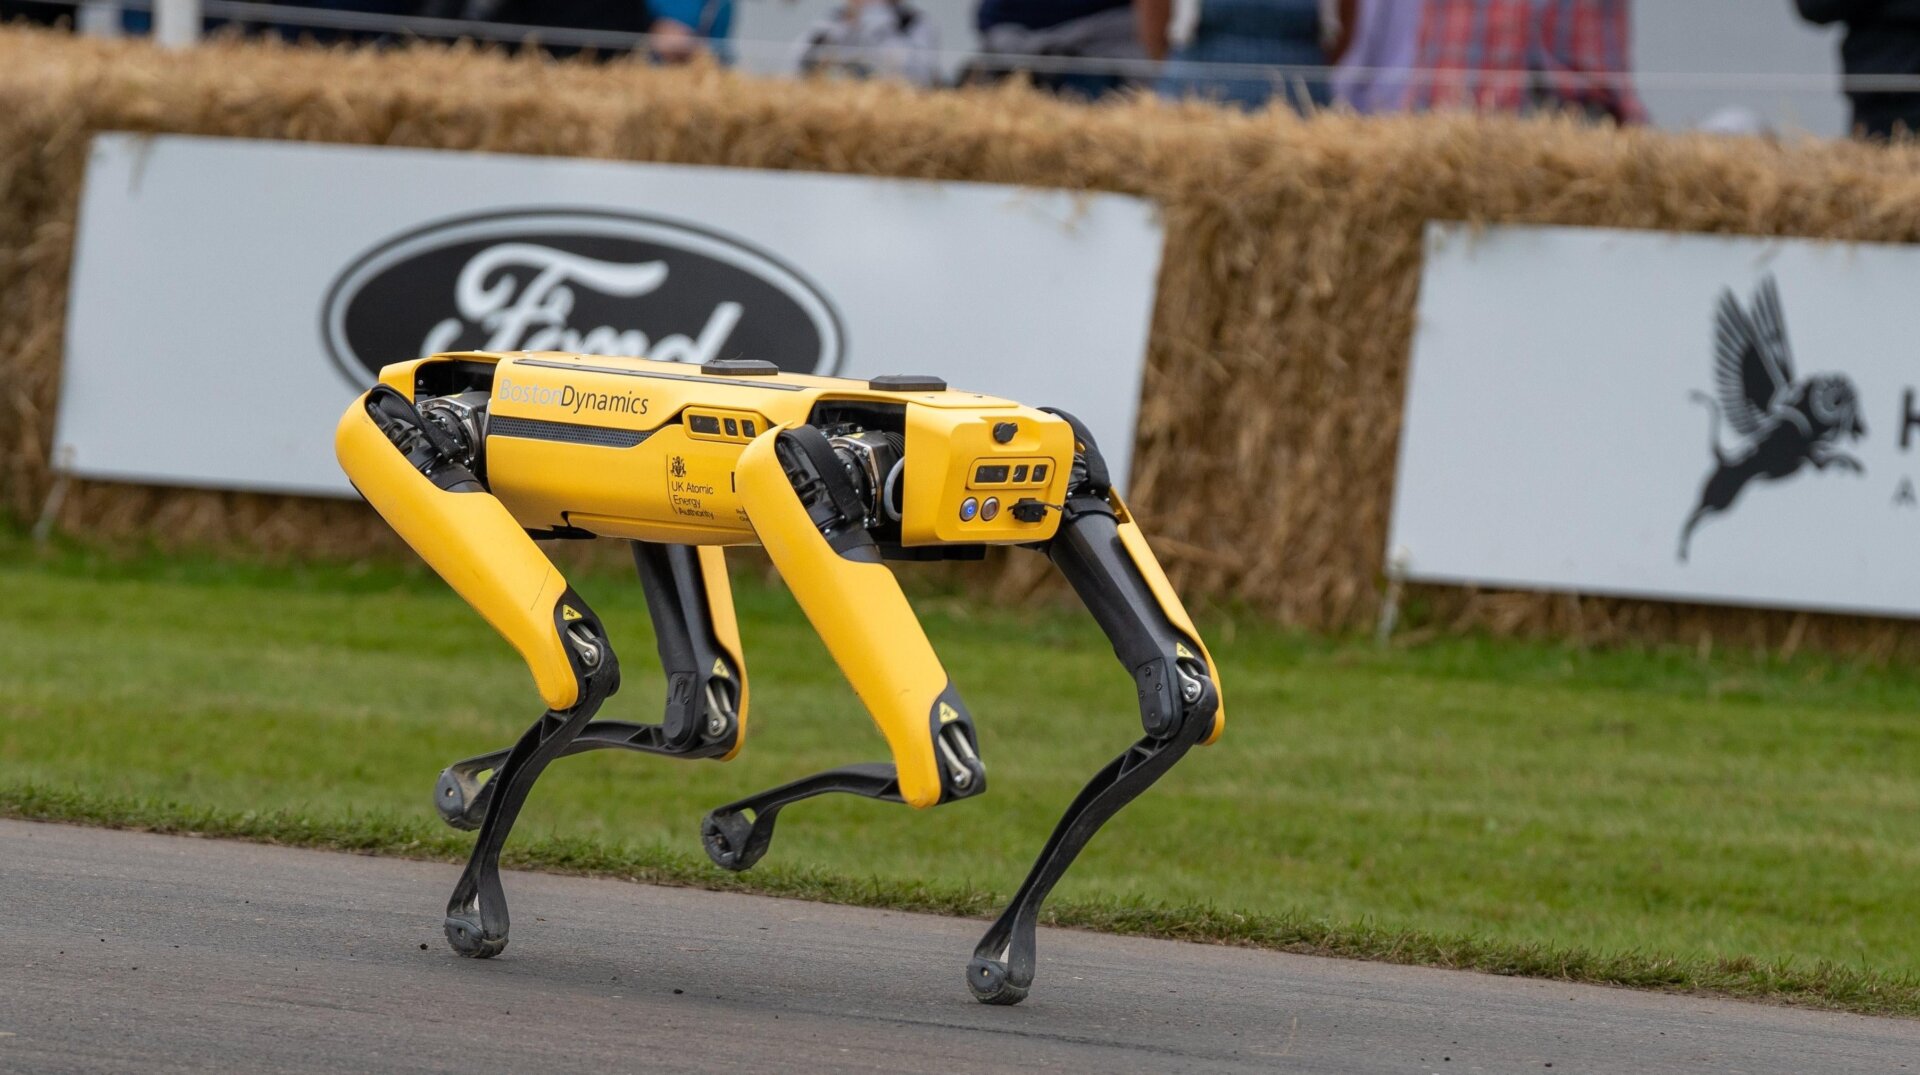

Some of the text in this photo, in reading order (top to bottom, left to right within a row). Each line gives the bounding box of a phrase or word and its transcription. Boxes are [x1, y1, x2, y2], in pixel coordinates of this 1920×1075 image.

[671, 481, 713, 495] UK Atomic
[673, 494, 700, 507] Energy
[678, 507, 714, 519] Authority
